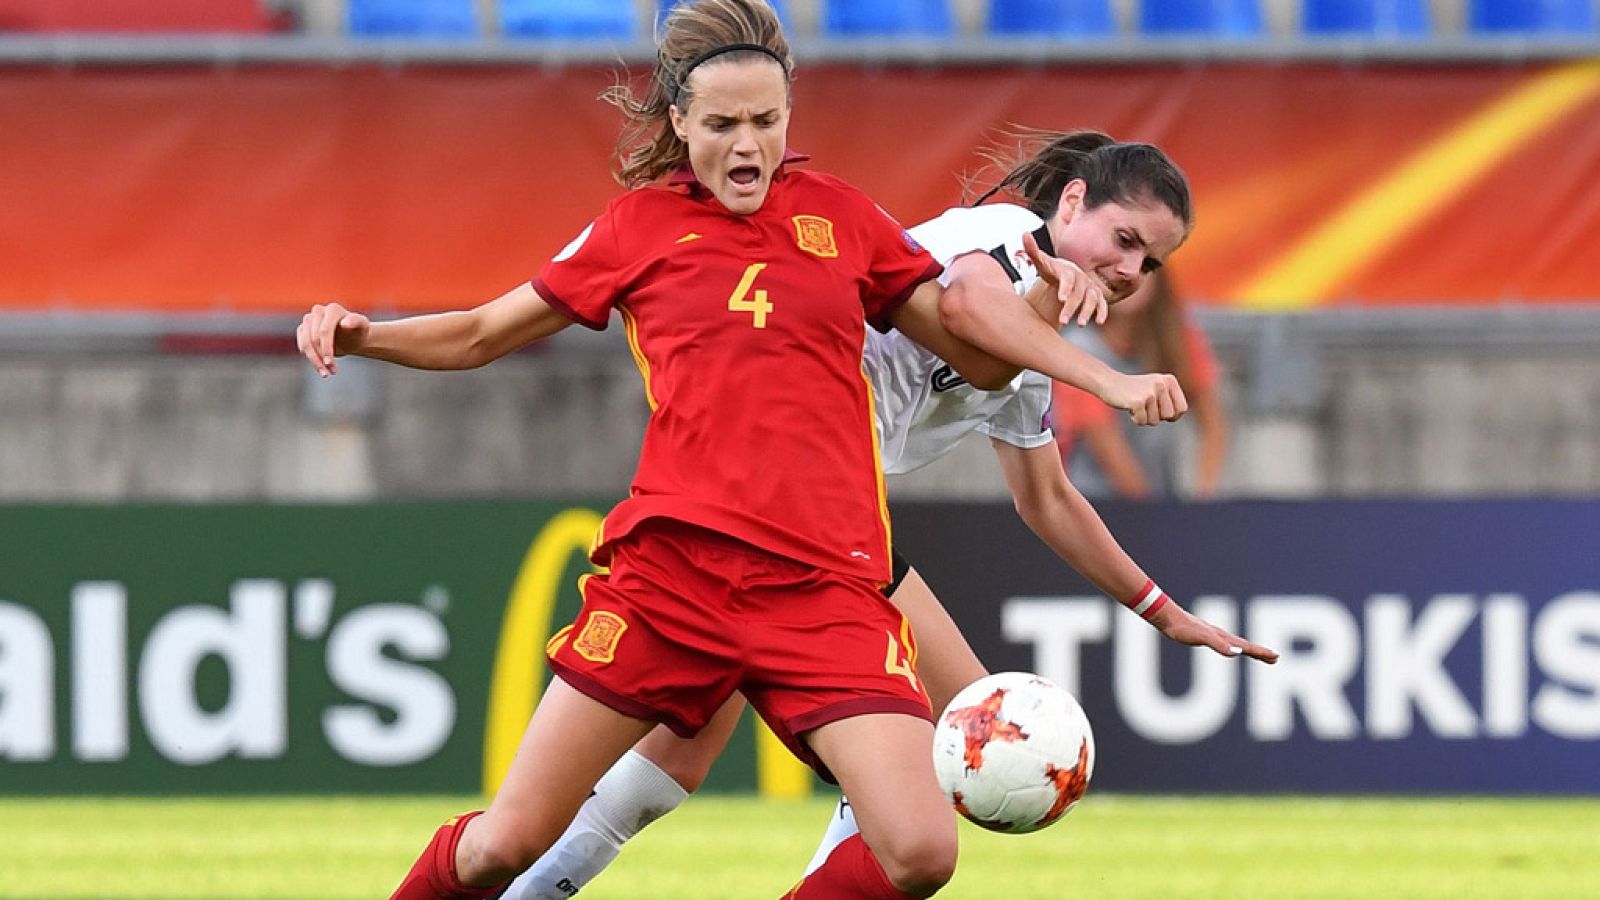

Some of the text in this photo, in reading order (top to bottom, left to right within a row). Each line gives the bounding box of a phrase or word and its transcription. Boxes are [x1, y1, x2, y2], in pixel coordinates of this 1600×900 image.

[728, 263, 774, 328] 4
[885, 629, 919, 693] 4
[1002, 590, 1600, 744] TURKIS
